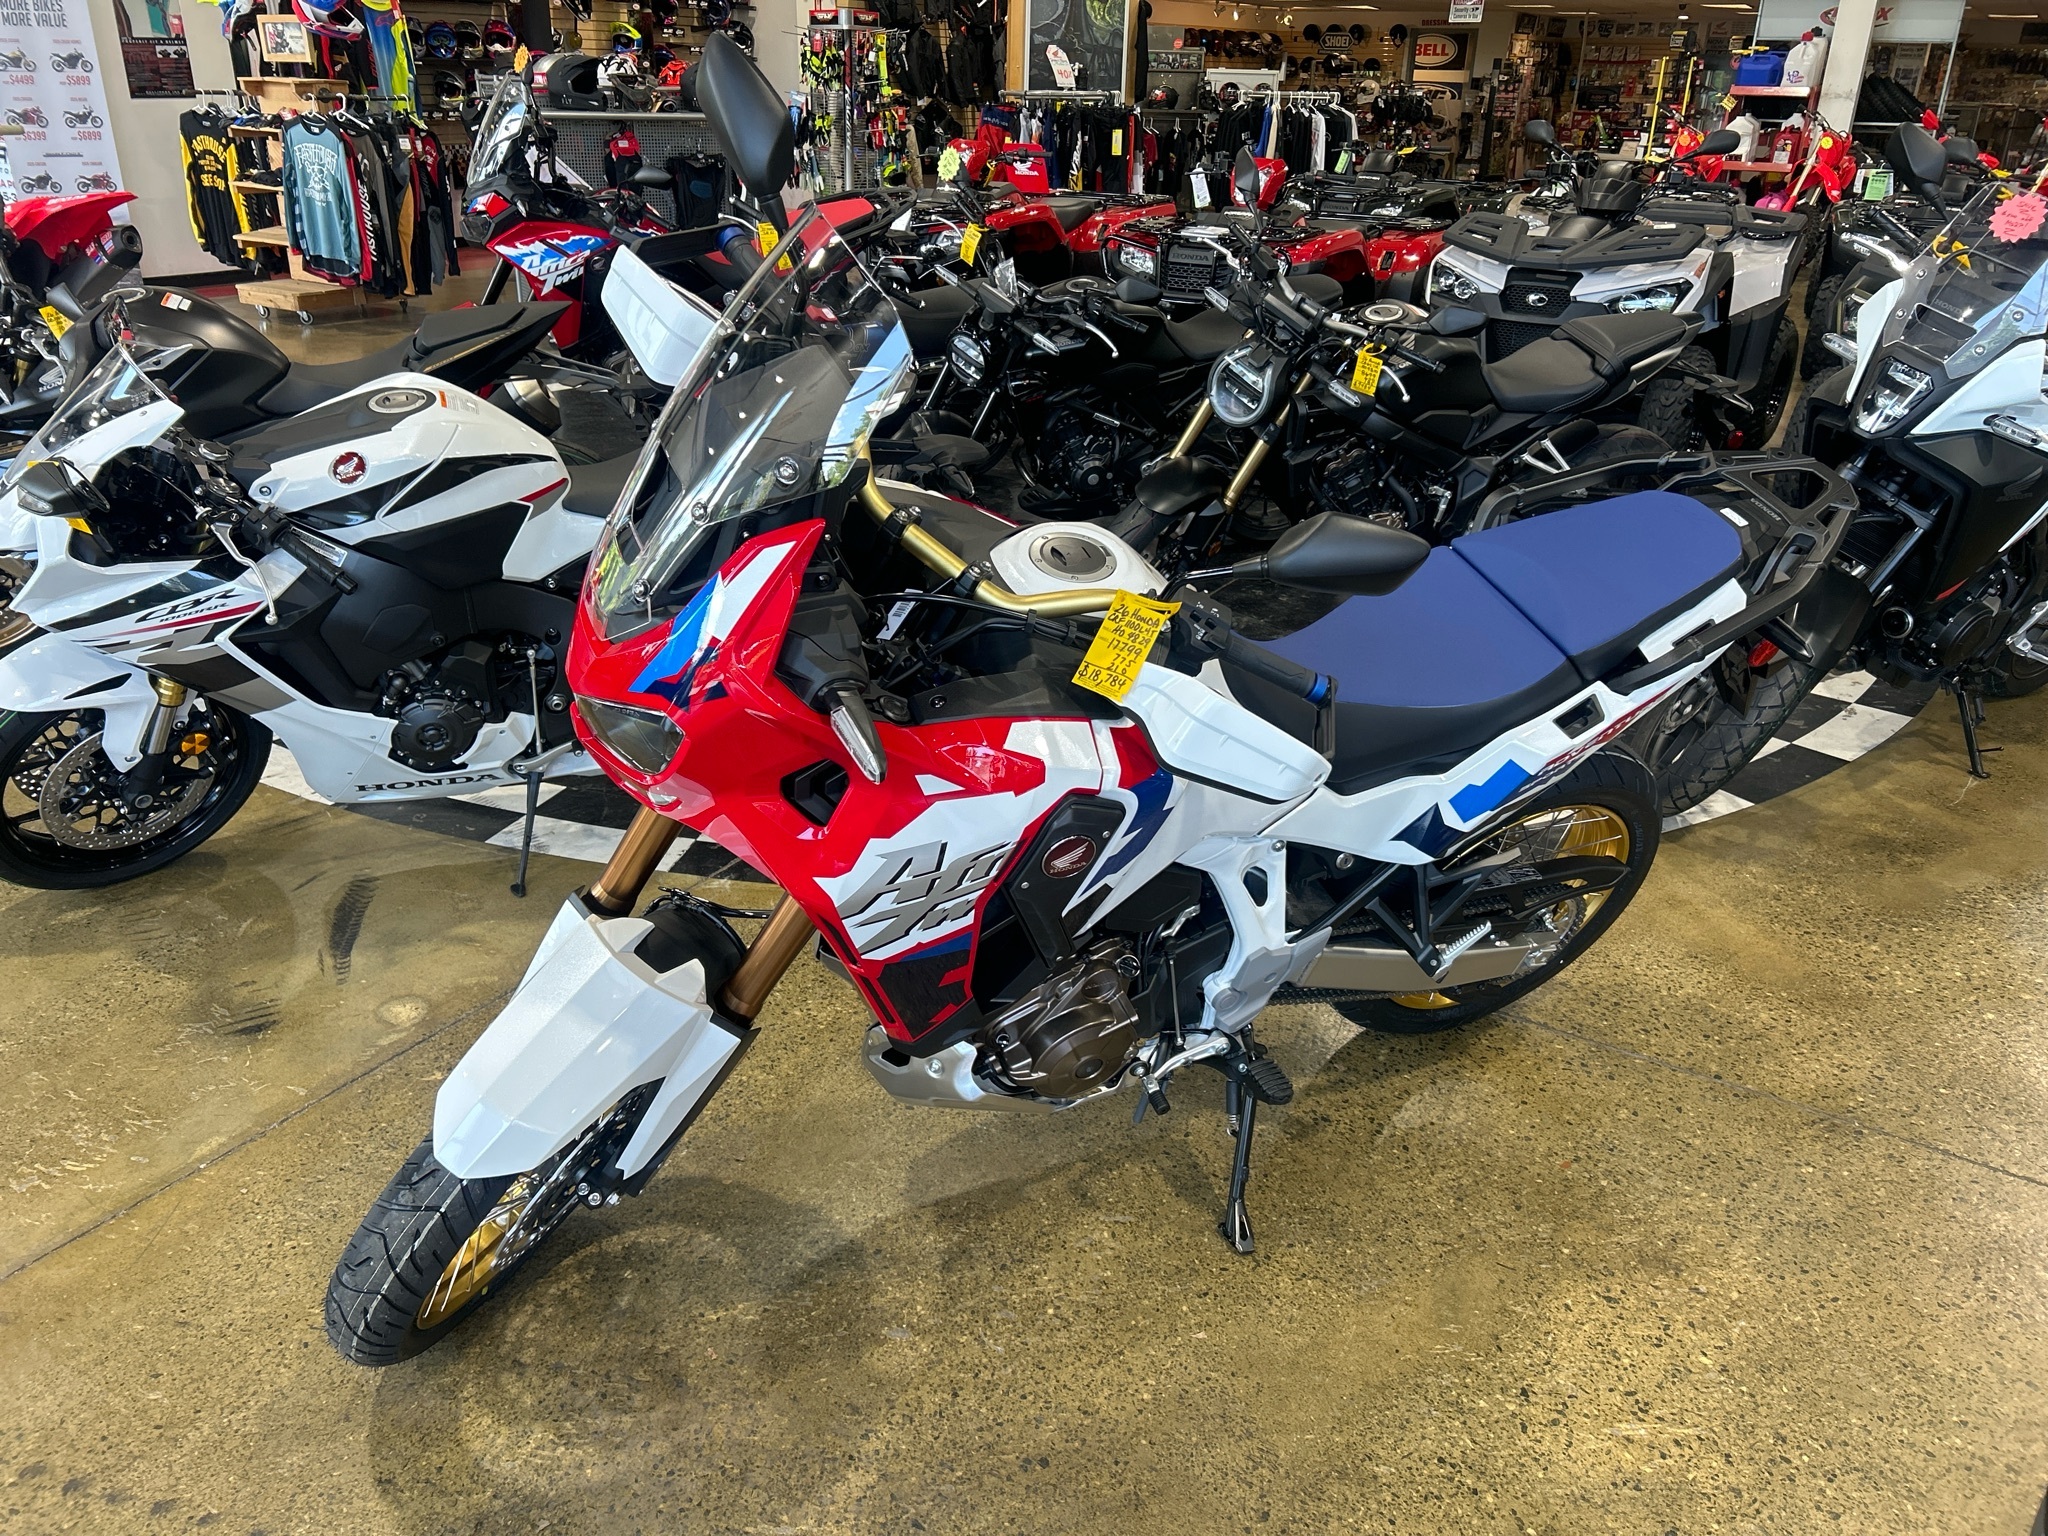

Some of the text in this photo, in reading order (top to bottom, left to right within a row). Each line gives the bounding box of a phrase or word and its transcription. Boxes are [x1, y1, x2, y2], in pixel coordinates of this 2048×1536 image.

[0, 0, 63, 12] MORE BIKES
[1, 12, 68, 28] MORE VALUE
[1324, 36, 1350, 47] SHOEI
[1415, 43, 1449, 57] BELL
[9, 74, 91, 86] $4499 $5899
[22, 130, 102, 141] $6399 $6899
[520, 249, 591, 277] Africa
[1172, 252, 1209, 262] HONDA
[1934, 299, 1964, 315] HOND
[38, 379, 66, 393] HON
[1750, 497, 1782, 521] HONDA
[134, 587, 244, 624] CBR
[160, 602, 231, 622] 1000RR
[1114, 603, 1129, 617] 26
[1107, 612, 1126, 625] CRF
[1107, 637, 1143, 661] 17799
[1112, 653, 1137, 668] 775
[1107, 662, 1127, 675] 210
[1078, 664, 1127, 691] $18,784
[354, 773, 505, 793] HONDA
[1050, 861, 1087, 874] HONDA
